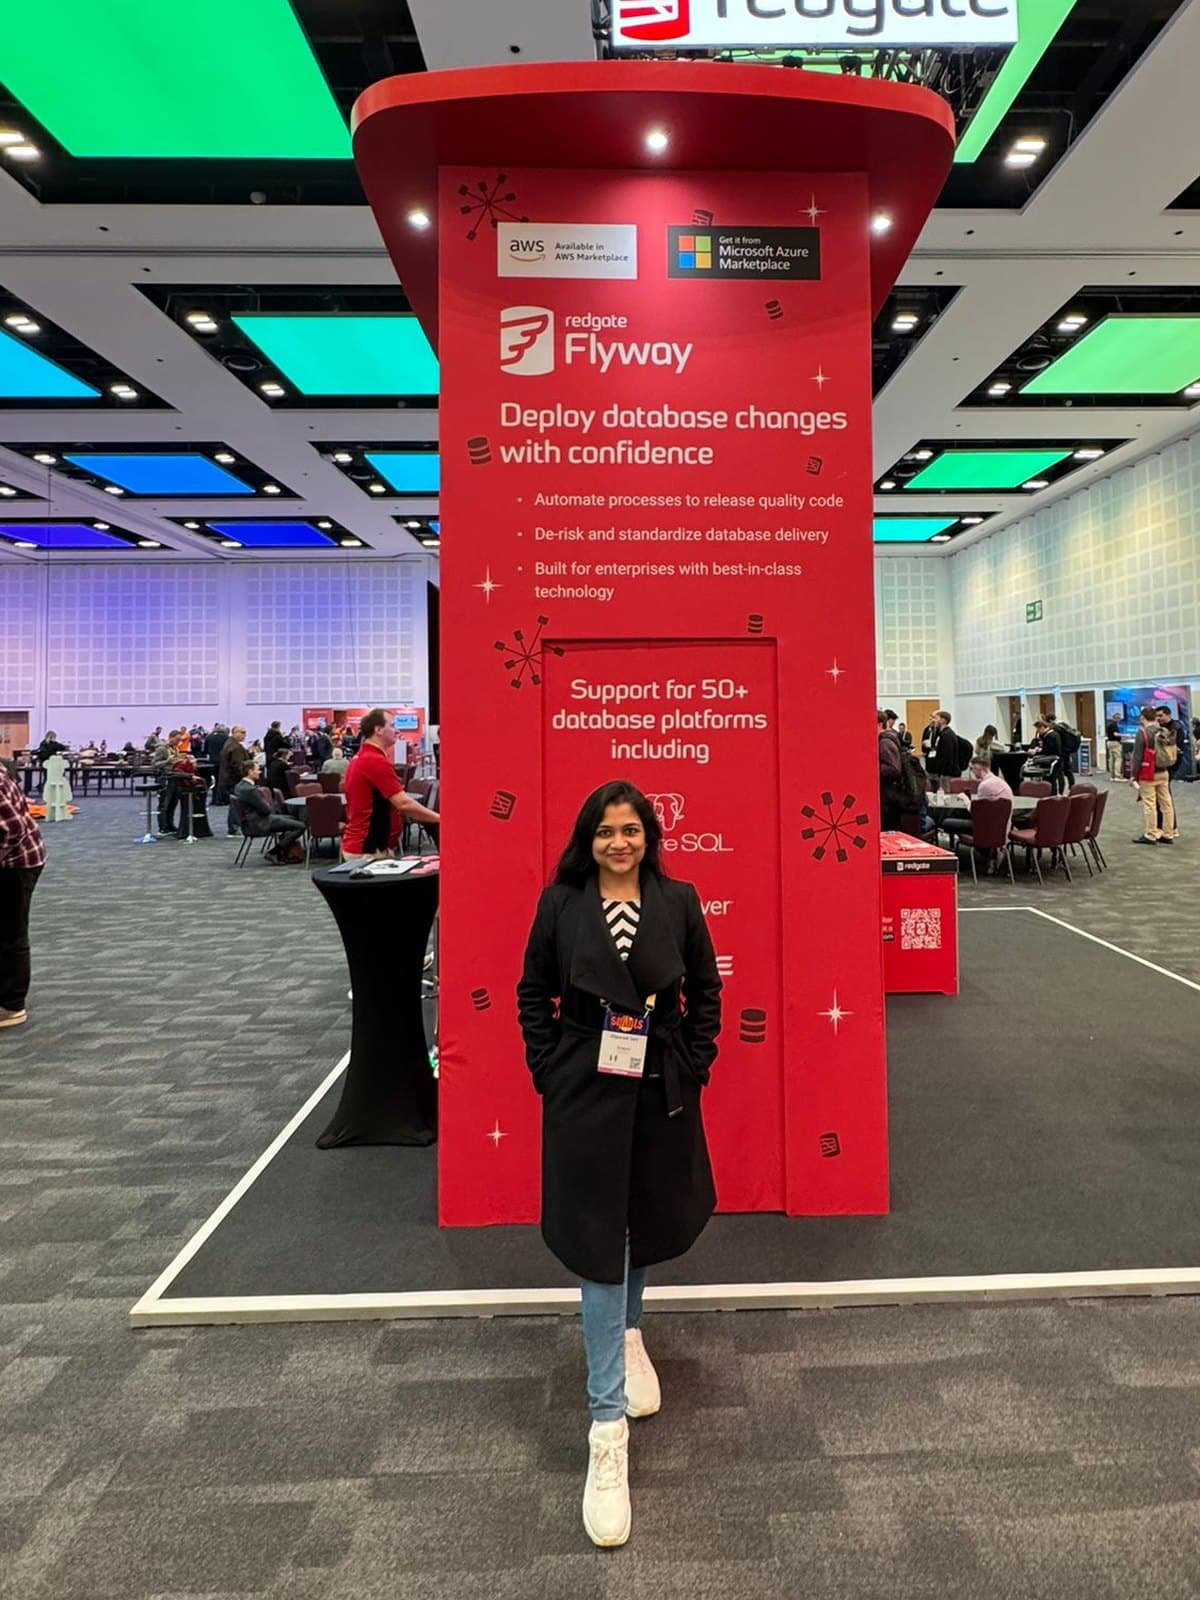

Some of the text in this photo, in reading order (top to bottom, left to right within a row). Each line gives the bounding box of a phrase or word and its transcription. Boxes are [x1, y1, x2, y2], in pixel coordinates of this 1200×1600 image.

[509, 239, 545, 253] aws
[554, 242, 605, 251] Available in
[718, 235, 761, 245] Get it from
[555, 253, 629, 263] AWS Marketplace
[718, 245, 809, 258] Microsoft Azure
[718, 258, 791, 272] Marketplace
[565, 312, 628, 332] redgate
[565, 332, 694, 374] Flyway
[501, 402, 848, 436] Deploy database changes
[500, 440, 714, 465] with confidence
[534, 492, 844, 510] Automate processes to release quality code
[535, 527, 830, 544] De-risk and standardize database delivery
[535, 561, 802, 578] Built for enterprises with best-in-class
[534, 584, 615, 601] technology
[570, 678, 749, 705] Support for 50+
[552, 708, 767, 734] database platforms
[610, 738, 710, 764] including
